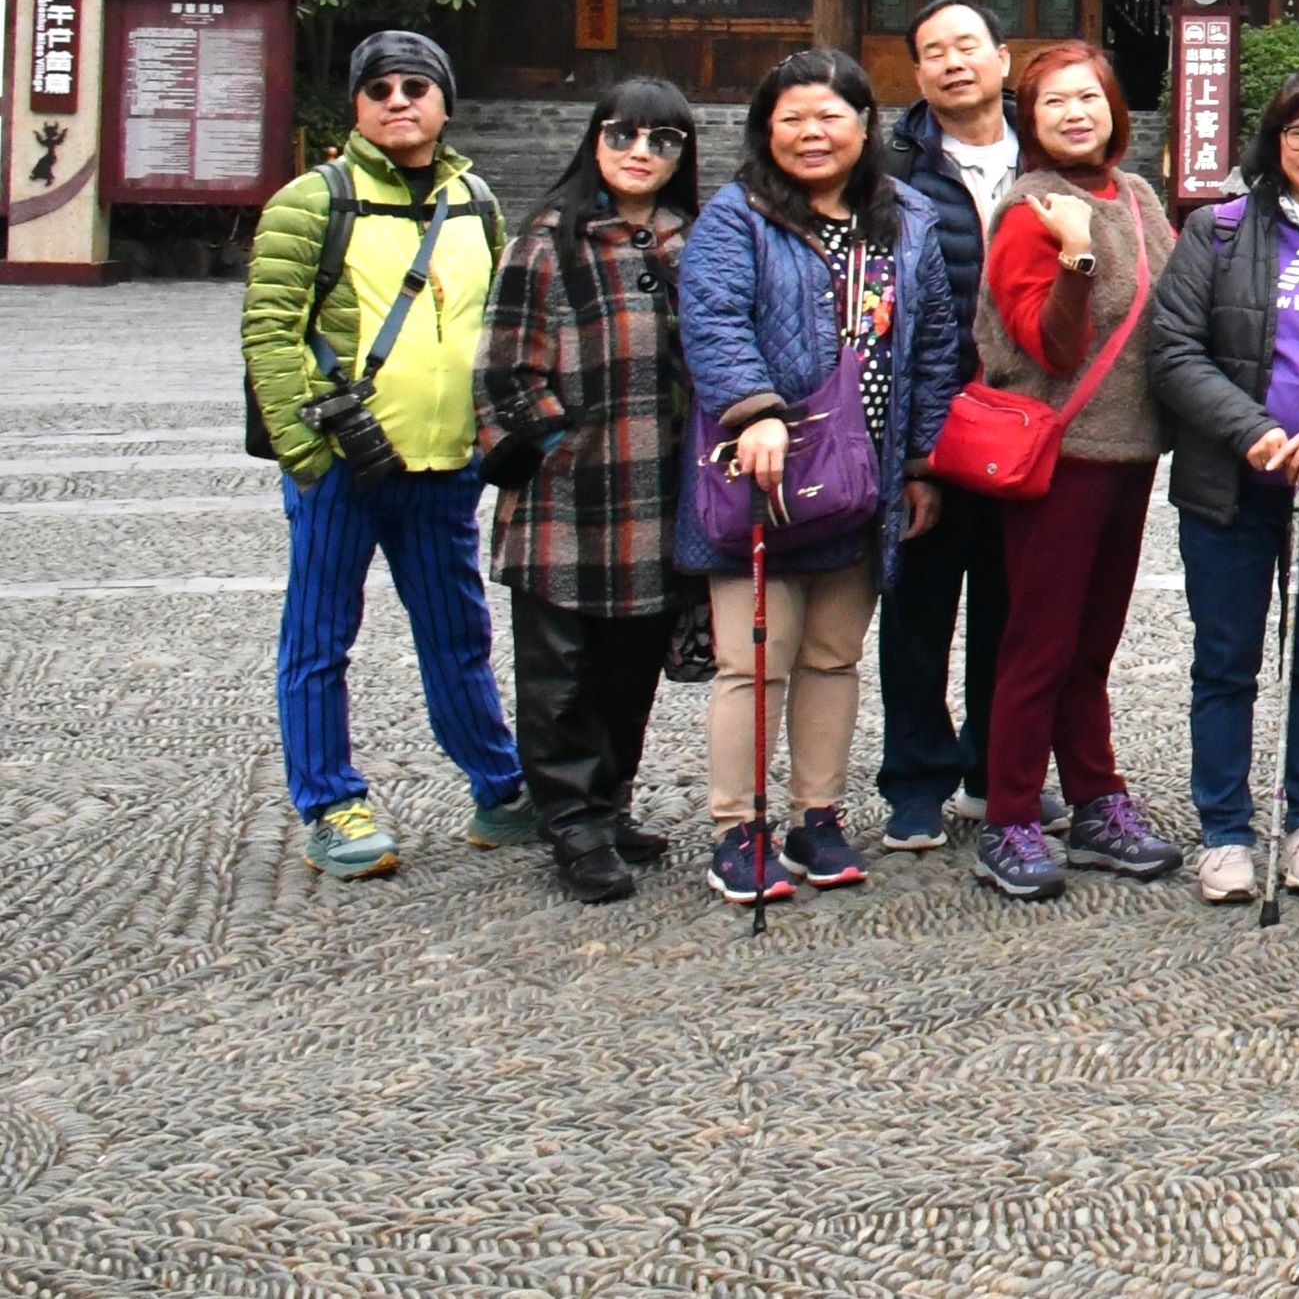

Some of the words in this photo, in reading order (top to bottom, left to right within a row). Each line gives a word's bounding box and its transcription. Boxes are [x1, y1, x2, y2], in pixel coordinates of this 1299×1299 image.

[33, 58, 45, 92] Village
[1194, 79, 1219, 170] 上客点
